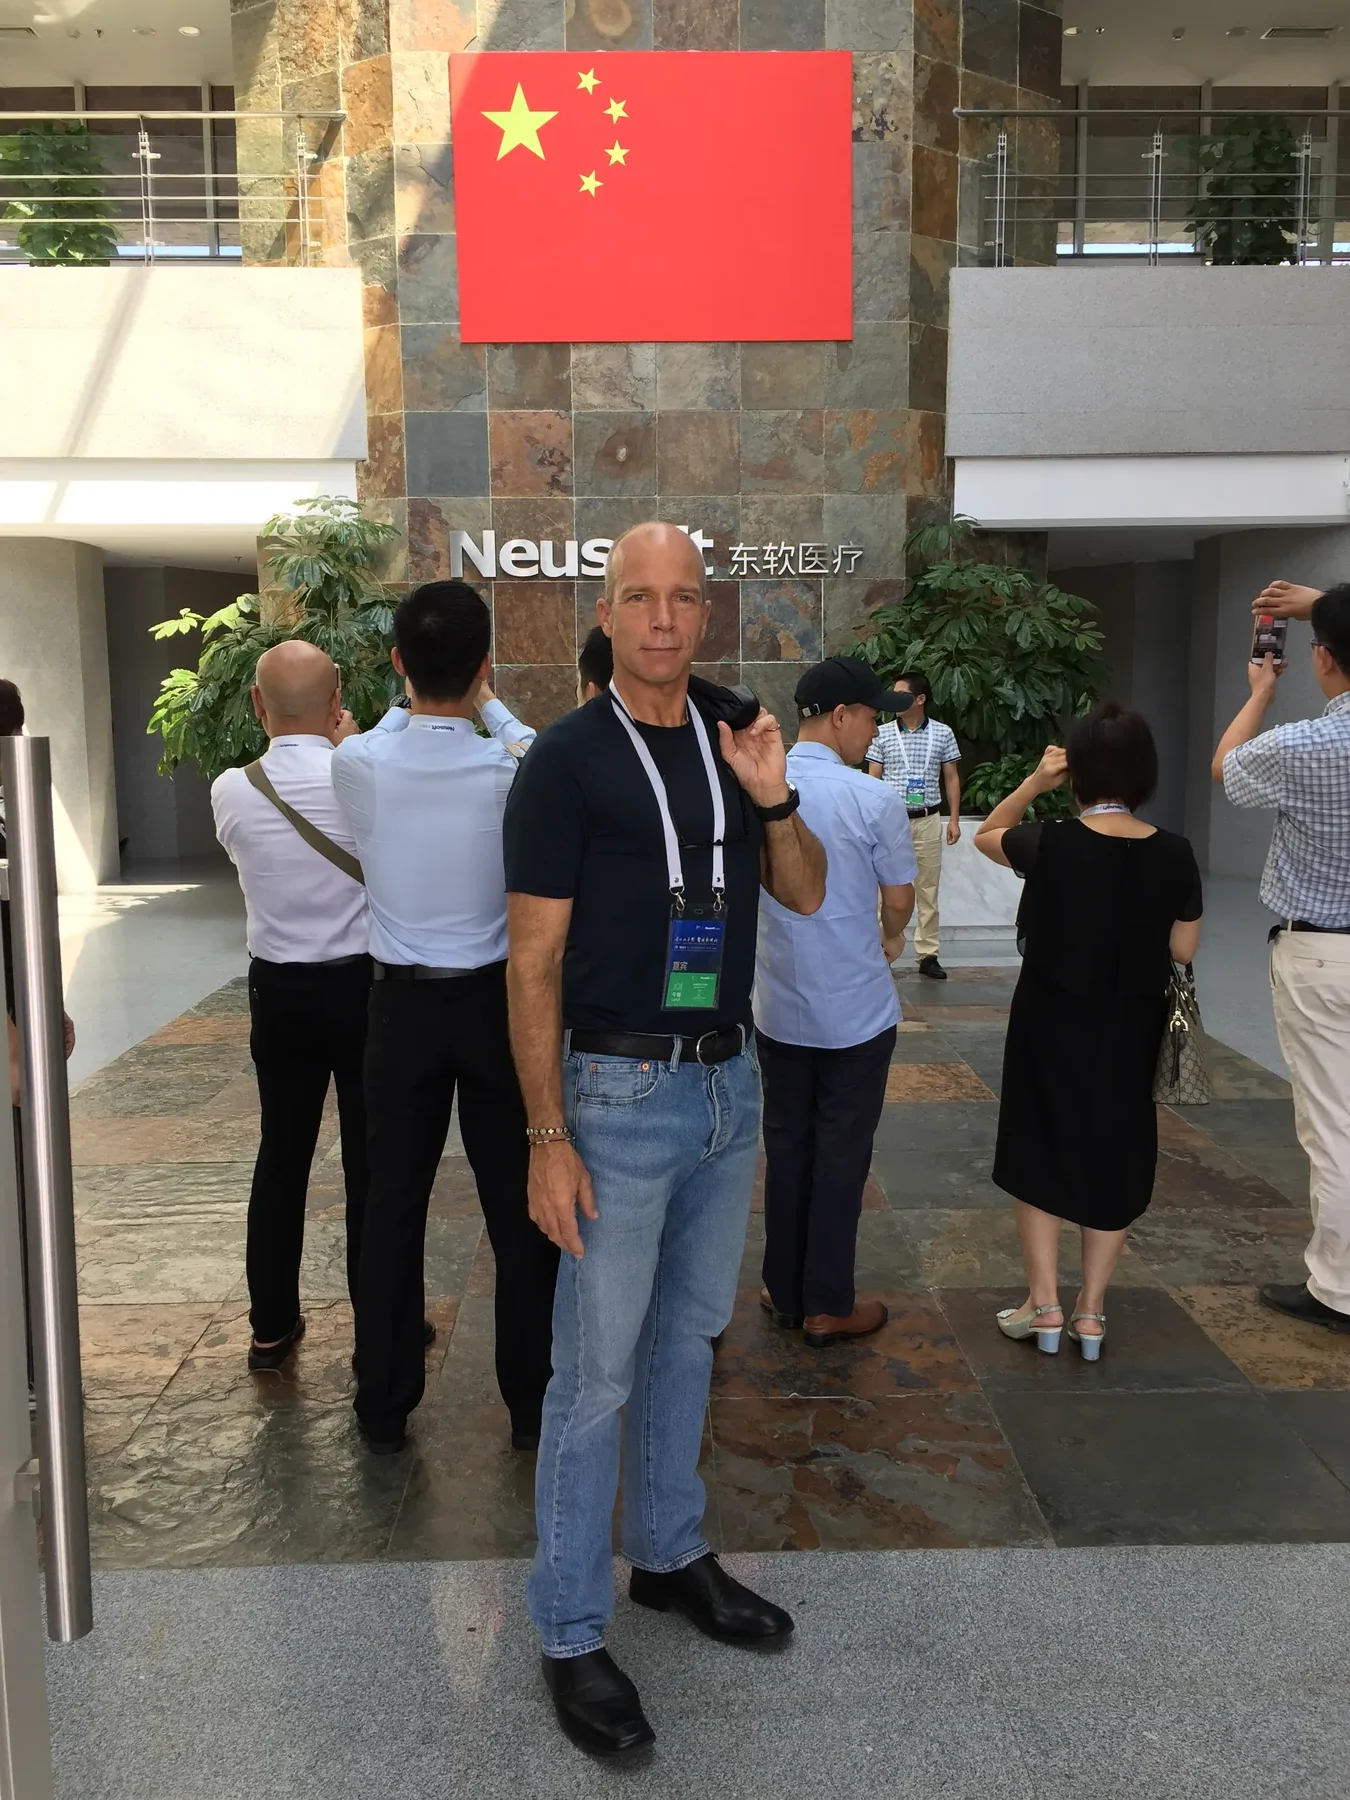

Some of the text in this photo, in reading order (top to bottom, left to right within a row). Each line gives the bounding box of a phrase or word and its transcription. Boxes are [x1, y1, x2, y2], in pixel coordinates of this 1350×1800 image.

[449, 525, 865, 578] Neust 东软医疗
